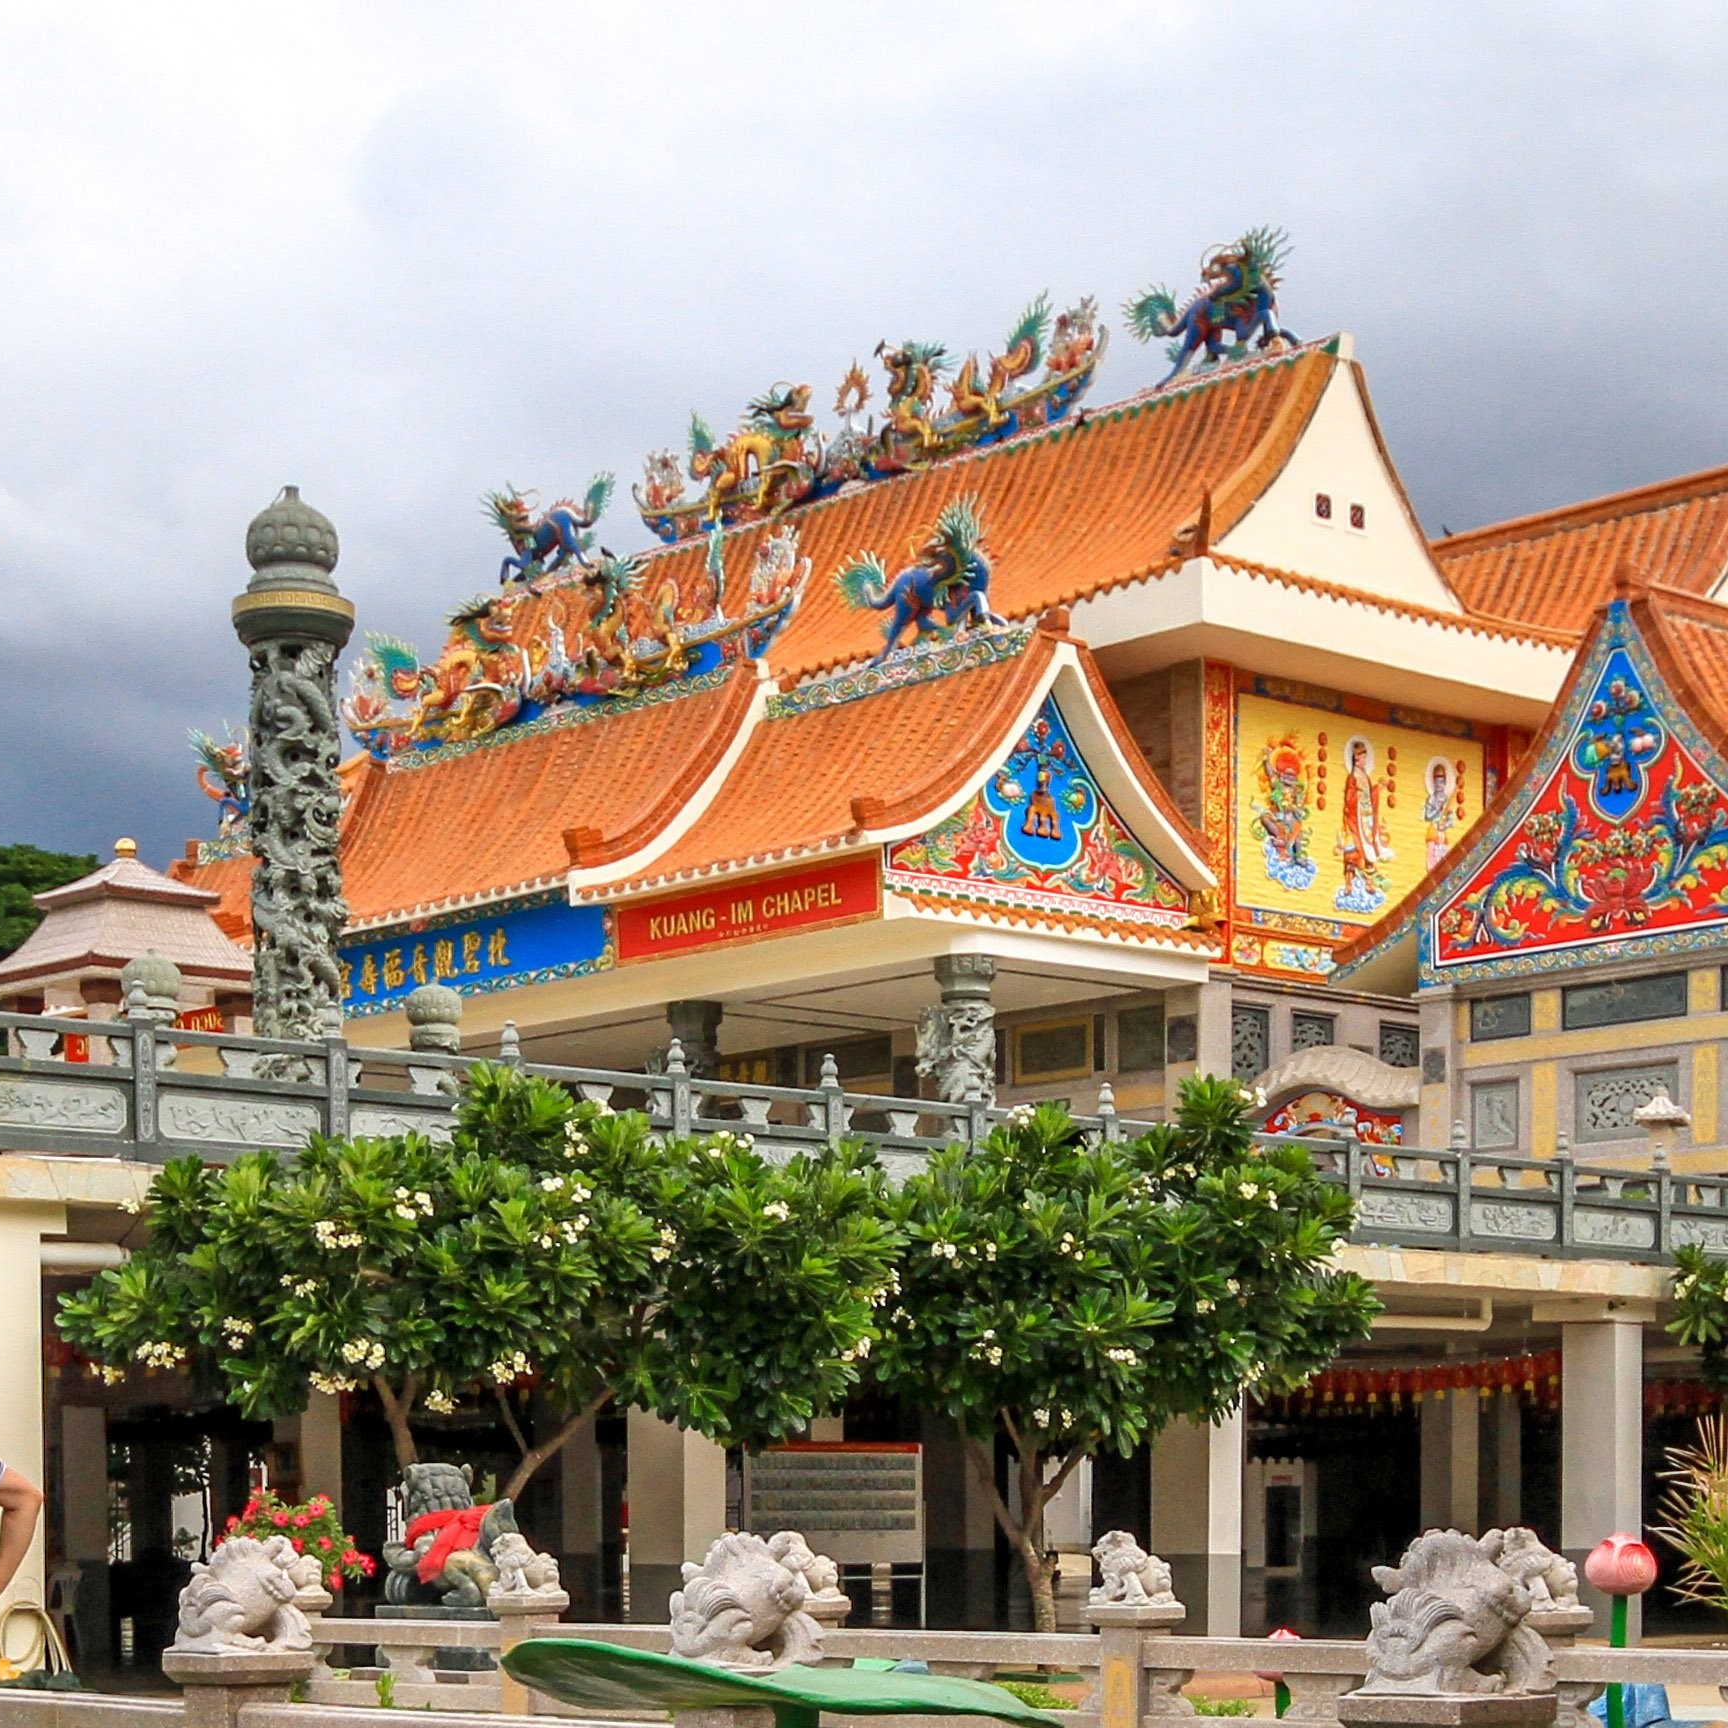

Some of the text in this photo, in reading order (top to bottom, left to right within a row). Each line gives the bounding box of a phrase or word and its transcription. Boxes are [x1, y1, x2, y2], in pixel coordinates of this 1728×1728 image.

[649, 908, 716, 941] KUANG
[730, 899, 754, 925] IM
[761, 881, 843, 919] CHAPEL
